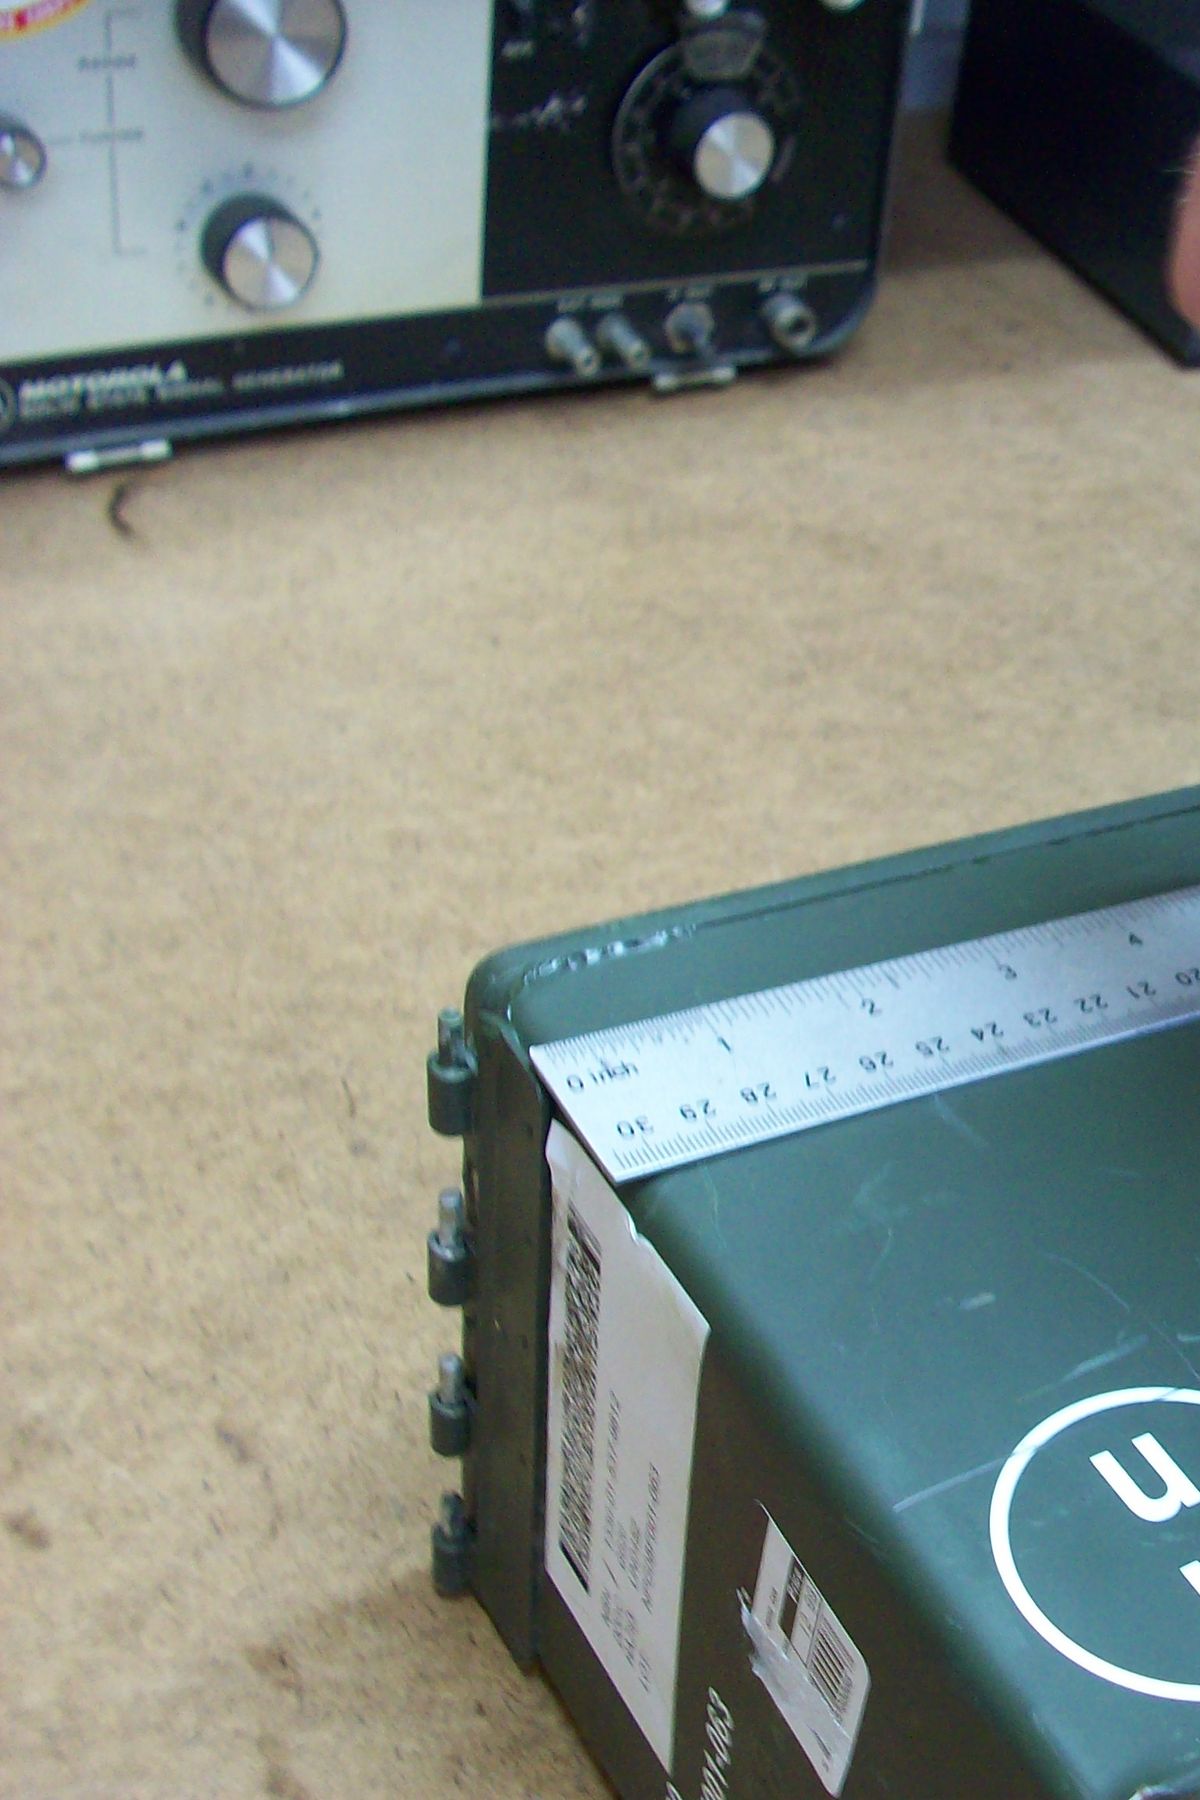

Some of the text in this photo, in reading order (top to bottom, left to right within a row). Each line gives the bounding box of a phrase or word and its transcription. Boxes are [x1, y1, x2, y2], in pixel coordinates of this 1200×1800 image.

[1126, 980, 1157, 1000] 21
[566, 1072, 585, 1092] 0
[589, 1058, 640, 1086] inch
[861, 998, 882, 1016] 2
[1000, 963, 1018, 981] 3
[1129, 931, 1144, 947] 4
[1073, 992, 1109, 1014] 22
[1023, 1007, 1058, 1028] 23
[971, 1020, 1005, 1043] 24
[915, 1036, 951, 1056] 25
[859, 1050, 895, 1072] 26
[804, 1064, 837, 1089] 27
[740, 1081, 778, 1105] 28
[679, 1098, 718, 1122] 29
[616, 1114, 654, 1138] 30
